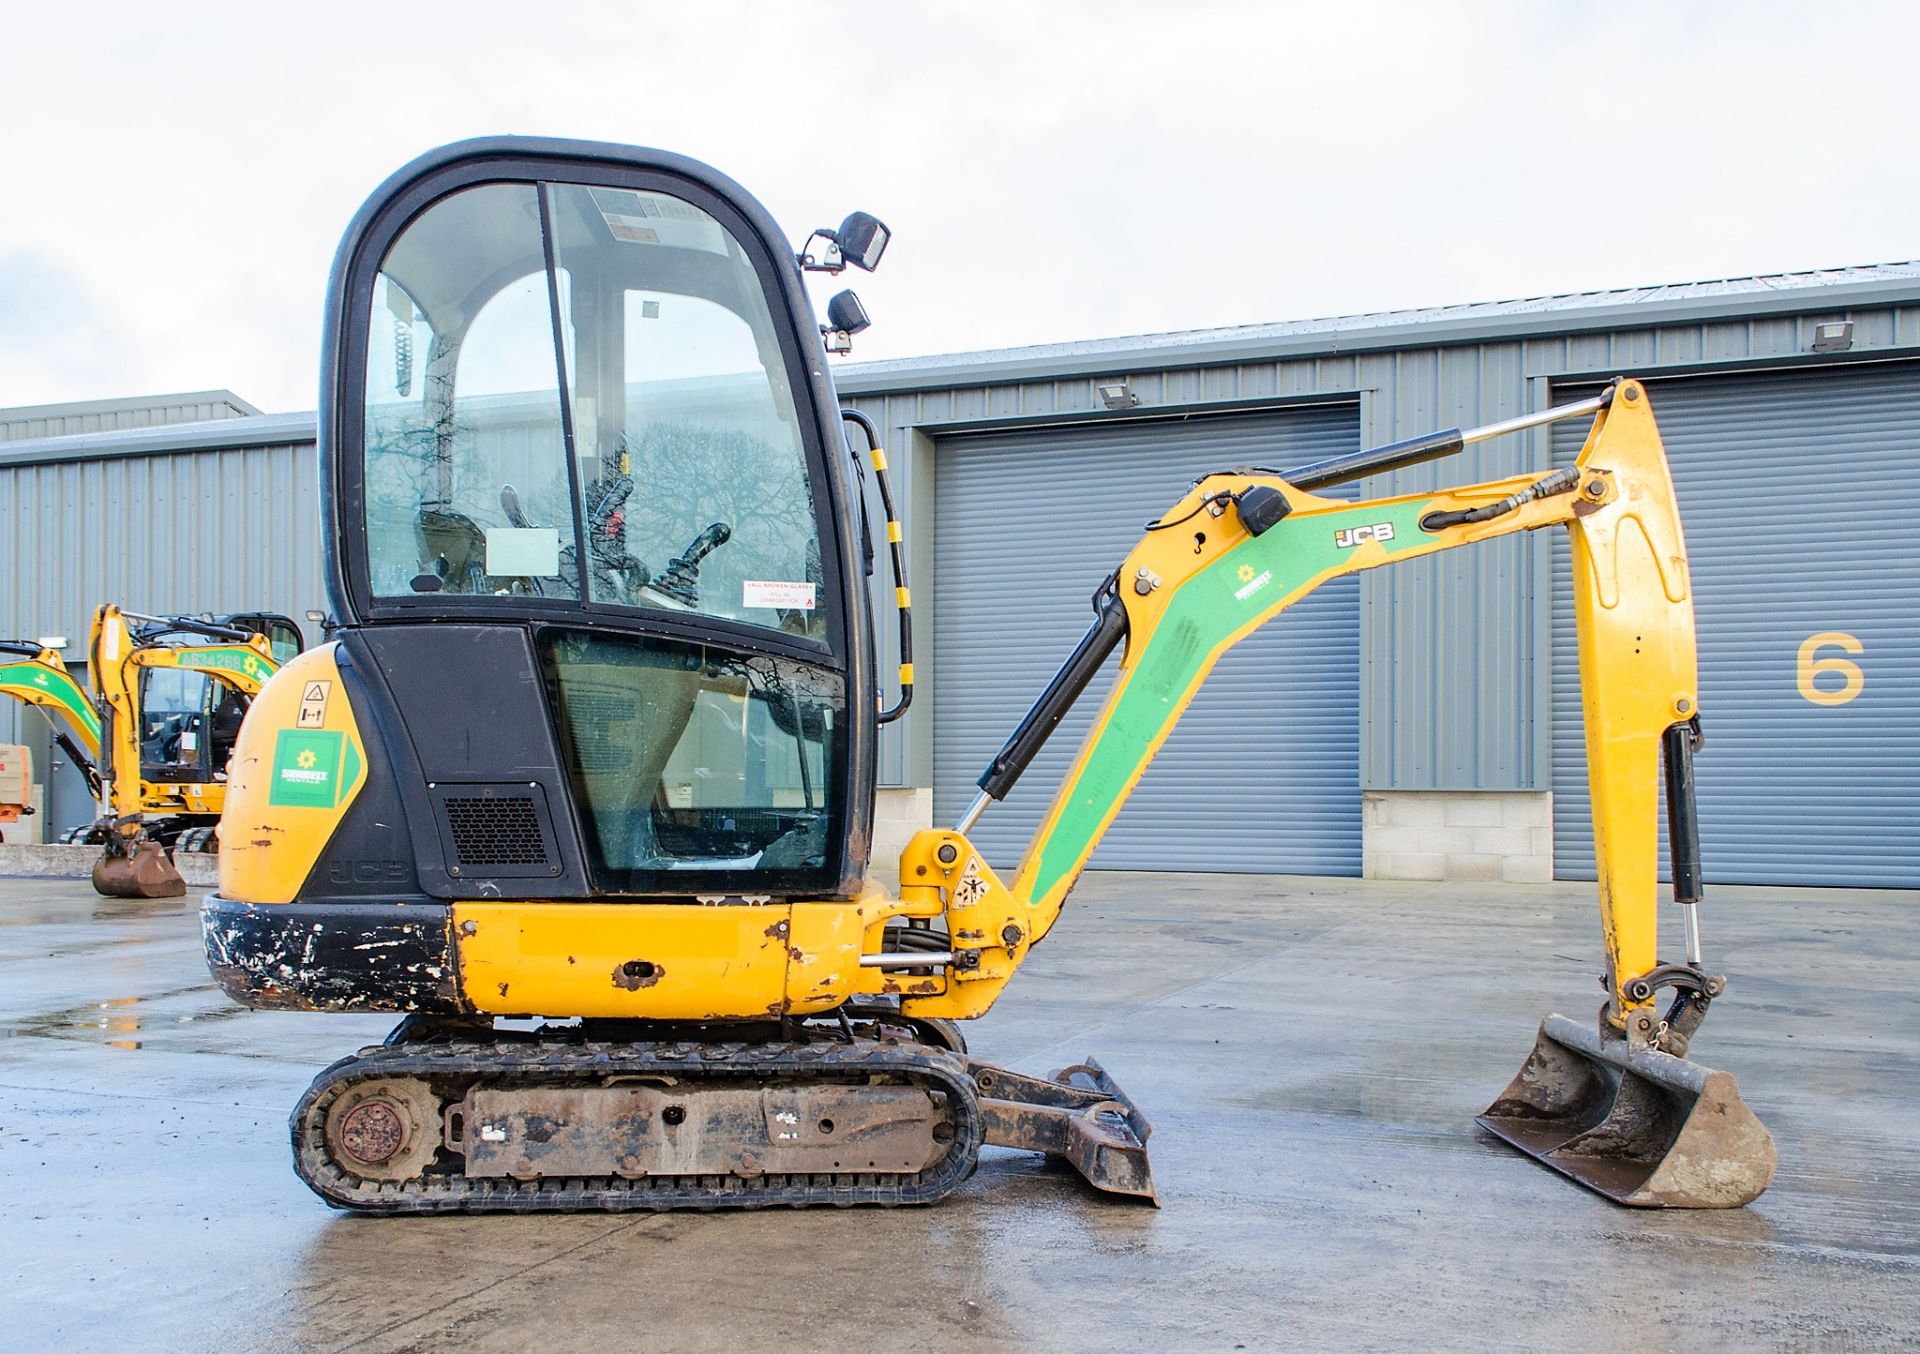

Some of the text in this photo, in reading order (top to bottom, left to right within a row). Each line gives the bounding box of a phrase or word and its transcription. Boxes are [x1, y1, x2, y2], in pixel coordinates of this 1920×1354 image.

[1335, 521, 1395, 549] JCB
[1796, 632, 1864, 706] 6
[329, 860, 411, 883] JCB
